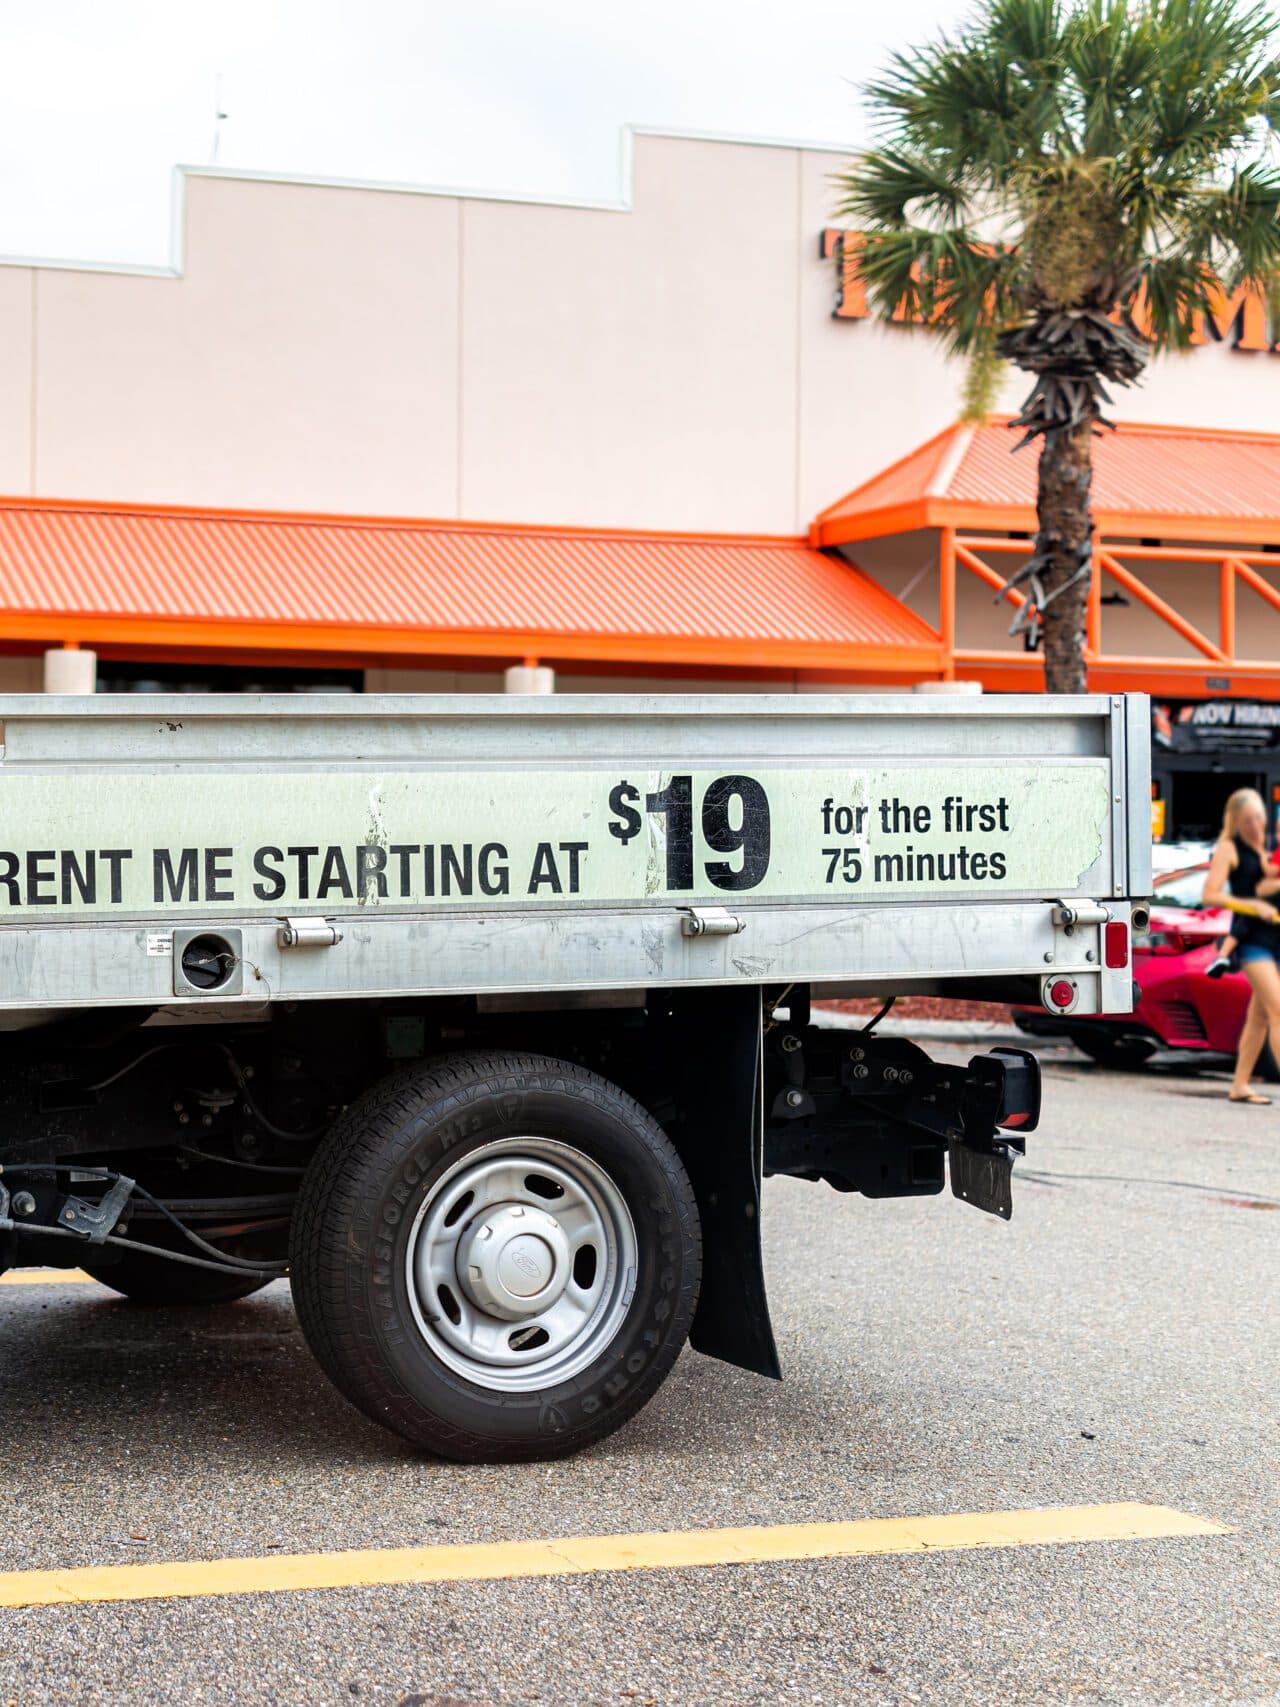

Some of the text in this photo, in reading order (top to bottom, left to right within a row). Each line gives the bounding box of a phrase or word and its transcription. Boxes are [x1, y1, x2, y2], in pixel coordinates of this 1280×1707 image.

[821, 796, 1010, 834] for the first
[152, 848, 234, 902] ME
[253, 842, 509, 901] STARTING
[527, 841, 589, 893] AT
[608, 775, 771, 891] $19
[821, 845, 1007, 883] 75 minutes
